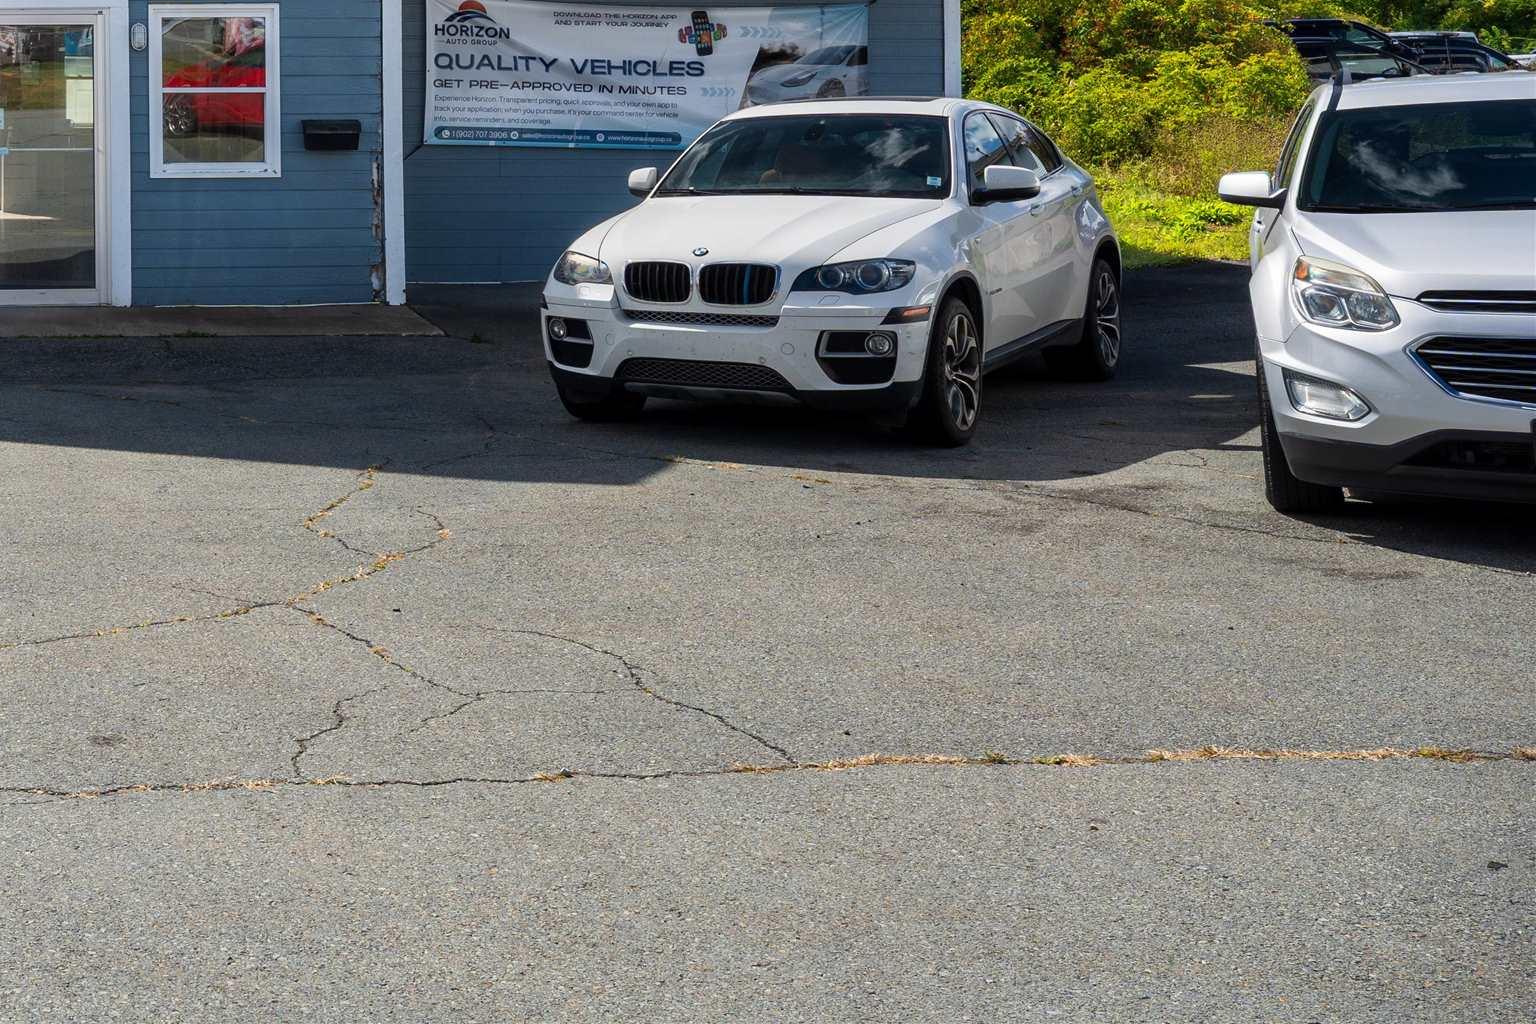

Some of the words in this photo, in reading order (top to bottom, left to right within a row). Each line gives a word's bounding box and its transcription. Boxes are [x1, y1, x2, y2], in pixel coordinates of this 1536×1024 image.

[434, 23, 510, 39] HORIZON
[470, 38, 498, 46] GROUP
[434, 52, 559, 73] QUALITY
[570, 57, 705, 77] VEHICLES
[433, 79, 464, 89] GET
[598, 84, 614, 94] IN
[618, 85, 687, 96] MINUTES
